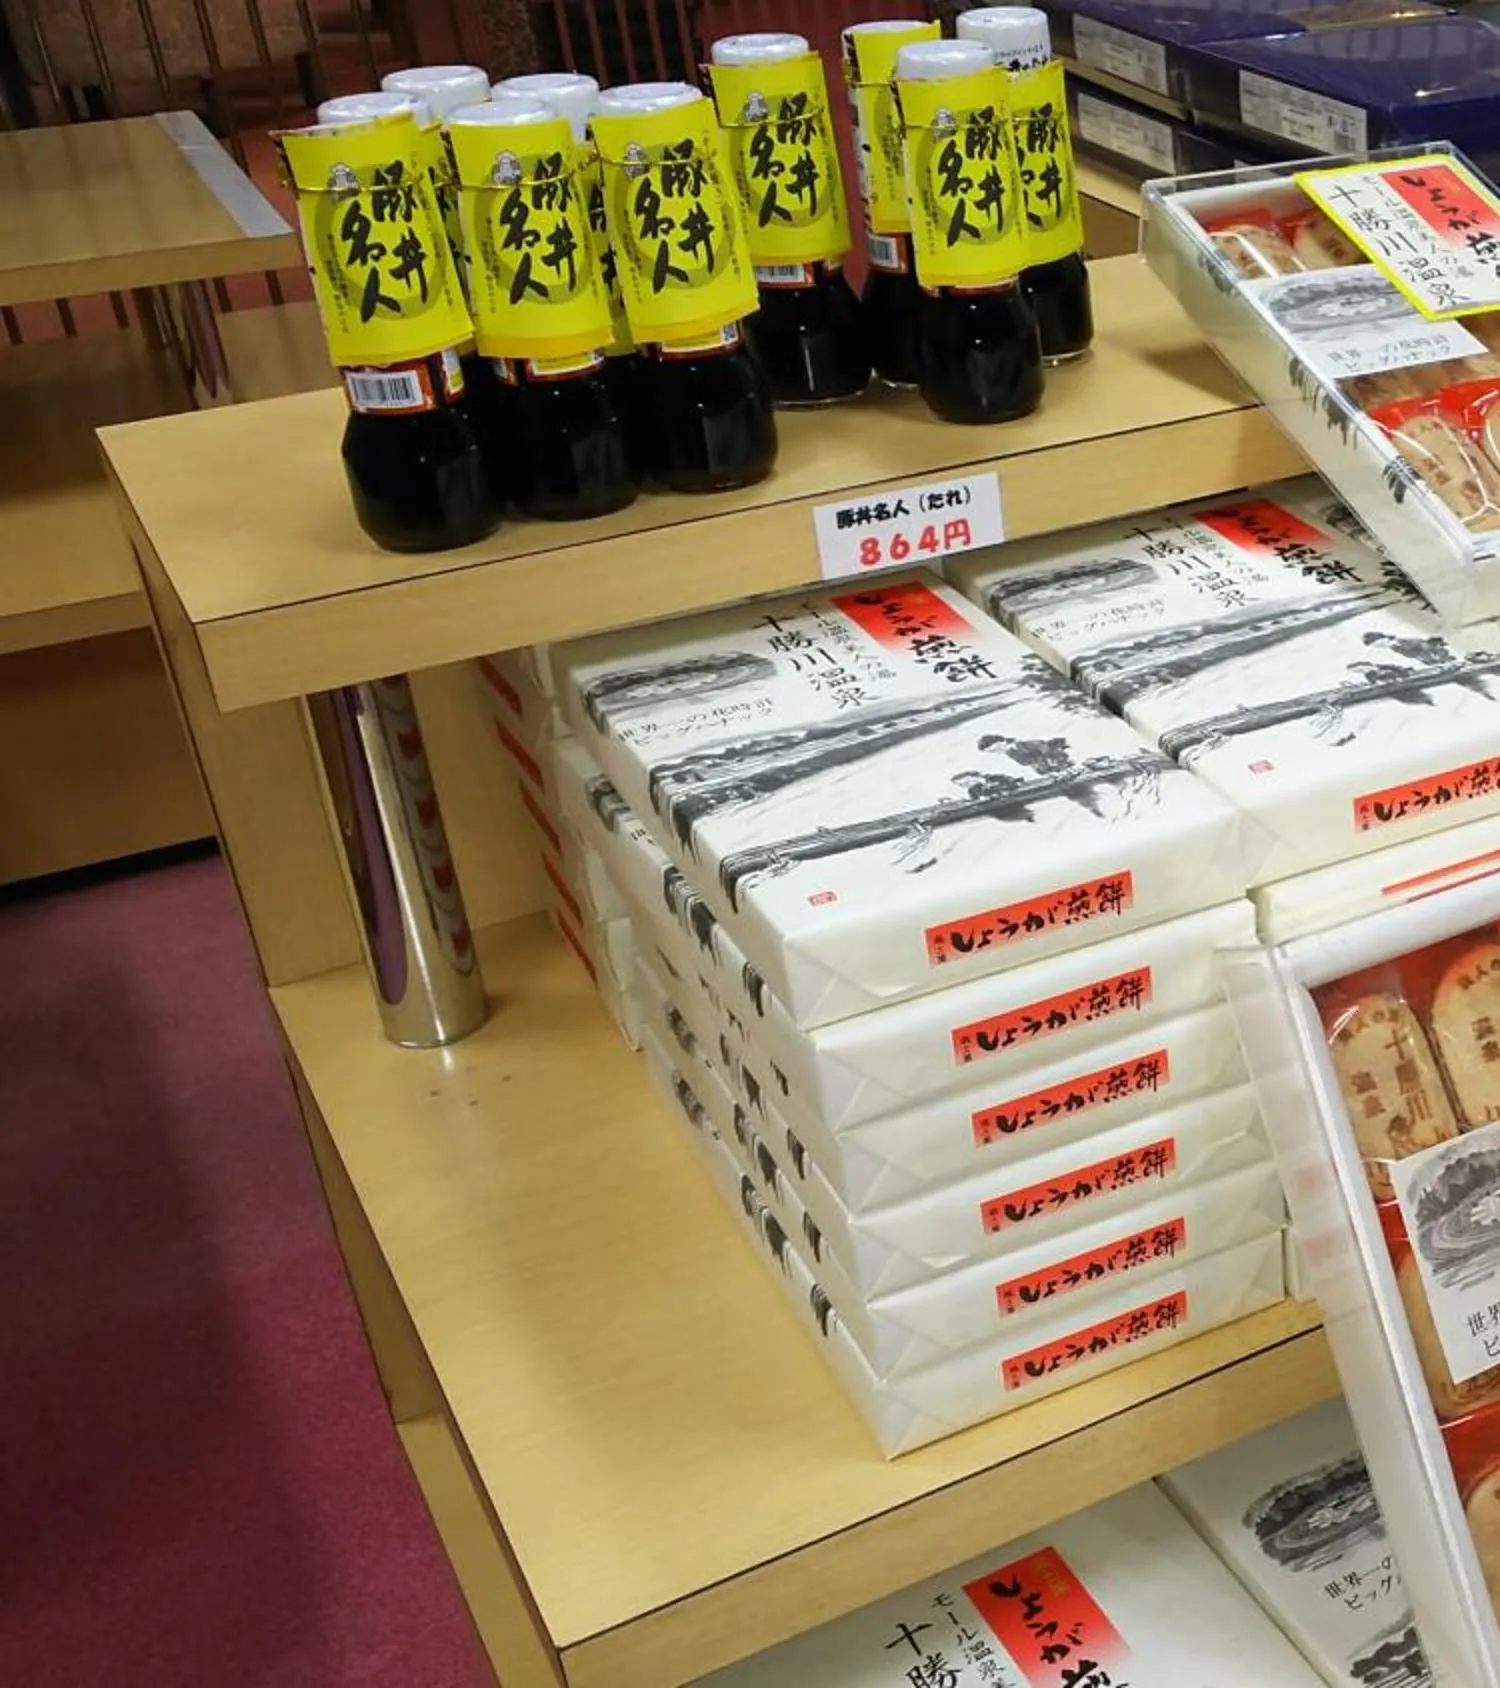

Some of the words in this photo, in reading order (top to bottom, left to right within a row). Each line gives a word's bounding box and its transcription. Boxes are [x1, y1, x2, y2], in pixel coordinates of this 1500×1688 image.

[750, 125, 792, 228] 名人
[938, 139, 981, 247] 名人
[341, 200, 403, 323] 名人
[500, 186, 549, 304] 名人
[635, 177, 689, 294] 名人
[1328, 185, 1471, 306] 十勝川温泉
[860, 518, 972, 566] 864円
[752, 614, 866, 709] 十勝川温泉
[951, 880, 1126, 953] しょうが煎餅
[976, 976, 1145, 1051] しょうが煎餅
[996, 1058, 1161, 1134] しょうが煎餅
[1004, 1146, 1168, 1222] しょうが煎餅
[1019, 1226, 1179, 1303] しょうが煎餅
[1023, 1300, 1179, 1377] しょうが煎餅
